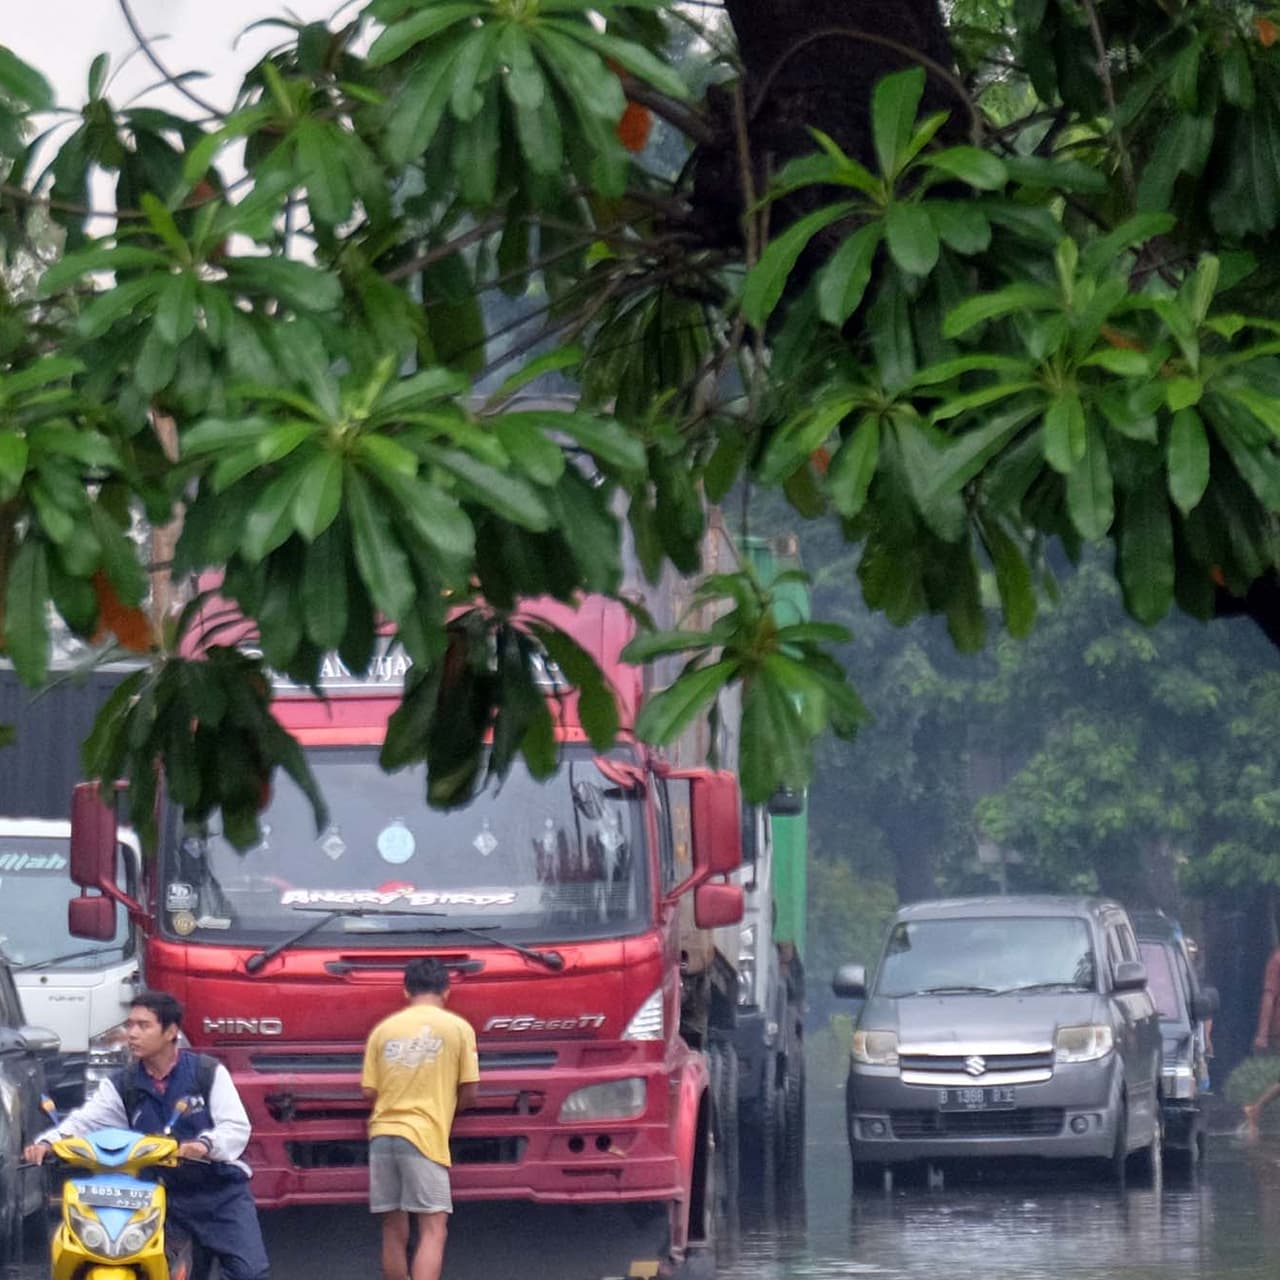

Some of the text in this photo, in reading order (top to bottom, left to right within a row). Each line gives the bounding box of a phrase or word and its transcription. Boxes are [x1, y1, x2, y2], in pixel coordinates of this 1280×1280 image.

[281, 889, 518, 906] ANGRY BIRDS
[203, 1017, 283, 1035] HINO
